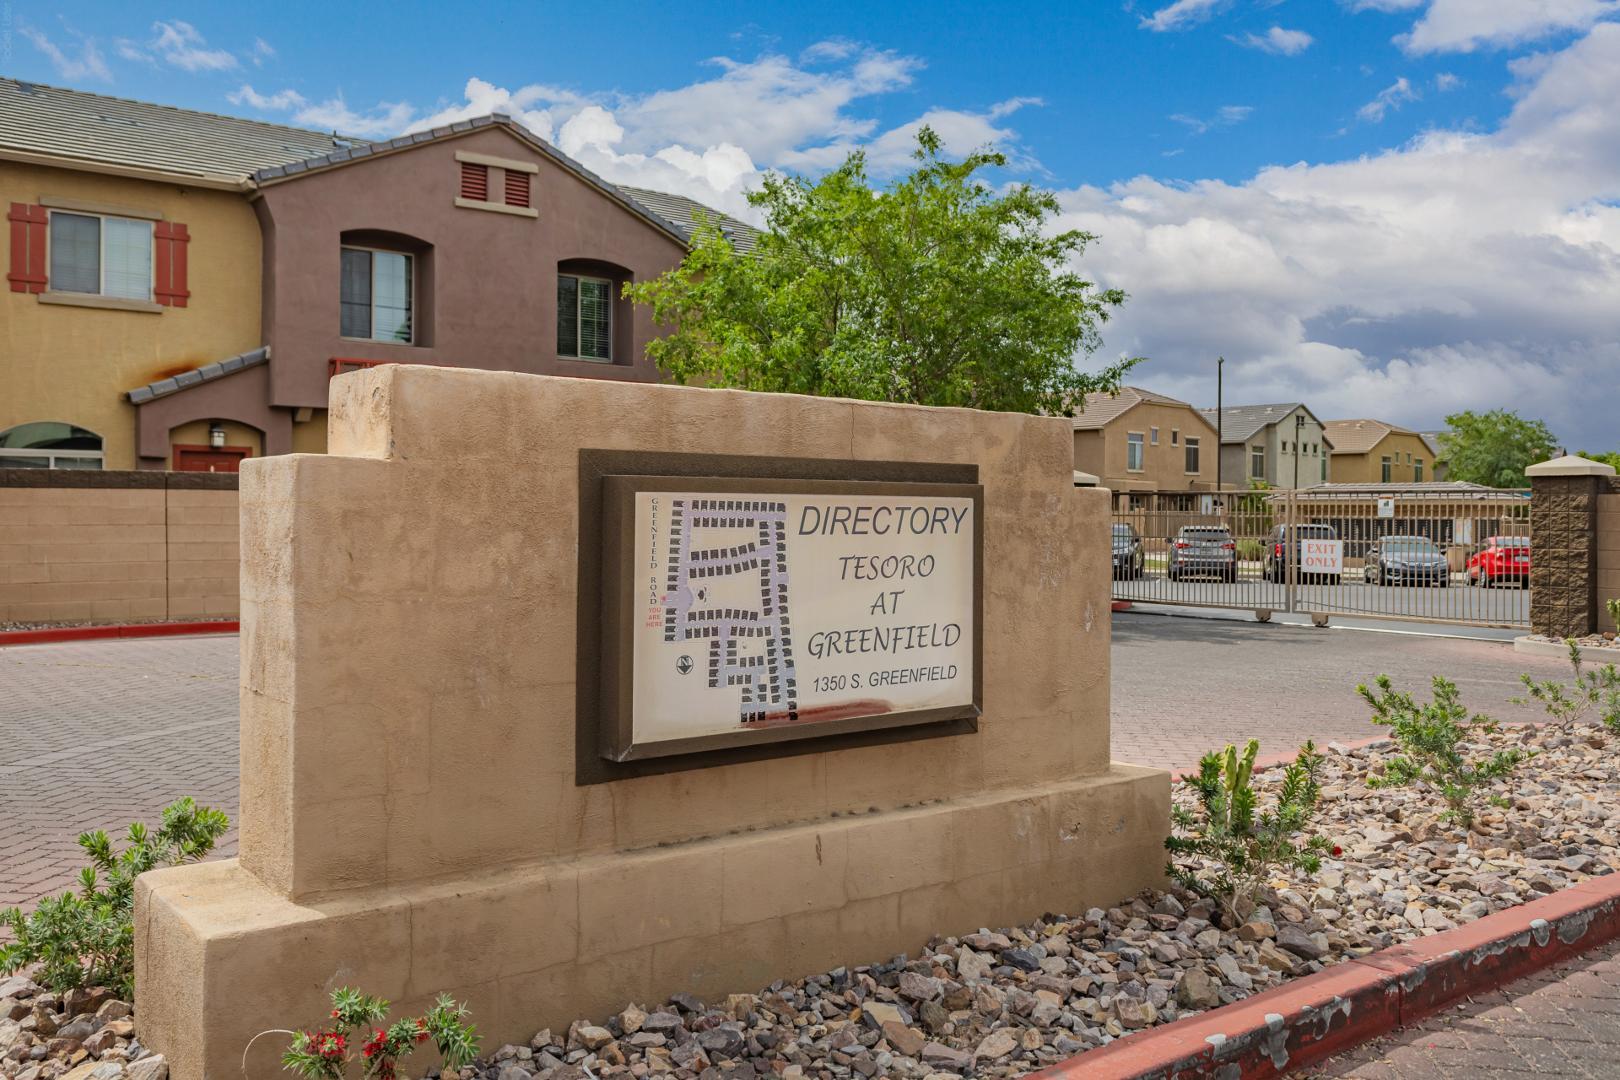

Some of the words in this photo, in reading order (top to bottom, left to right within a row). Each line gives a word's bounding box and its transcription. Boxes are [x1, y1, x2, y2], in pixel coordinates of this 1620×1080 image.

[650, 497, 659, 569] GREENFIELD
[798, 505, 968, 536] DIRECTORY
[1306, 556, 1337, 568] ONLY
[1307, 543, 1337, 554] EXIT
[838, 554, 935, 581] TESORO
[649, 576, 657, 605] ROAD
[870, 590, 905, 615] AT
[807, 622, 961, 659] GREENFIELD
[812, 675, 847, 693] 1350
[850, 673, 863, 689] S.
[869, 664, 958, 688] GREENFIELD
